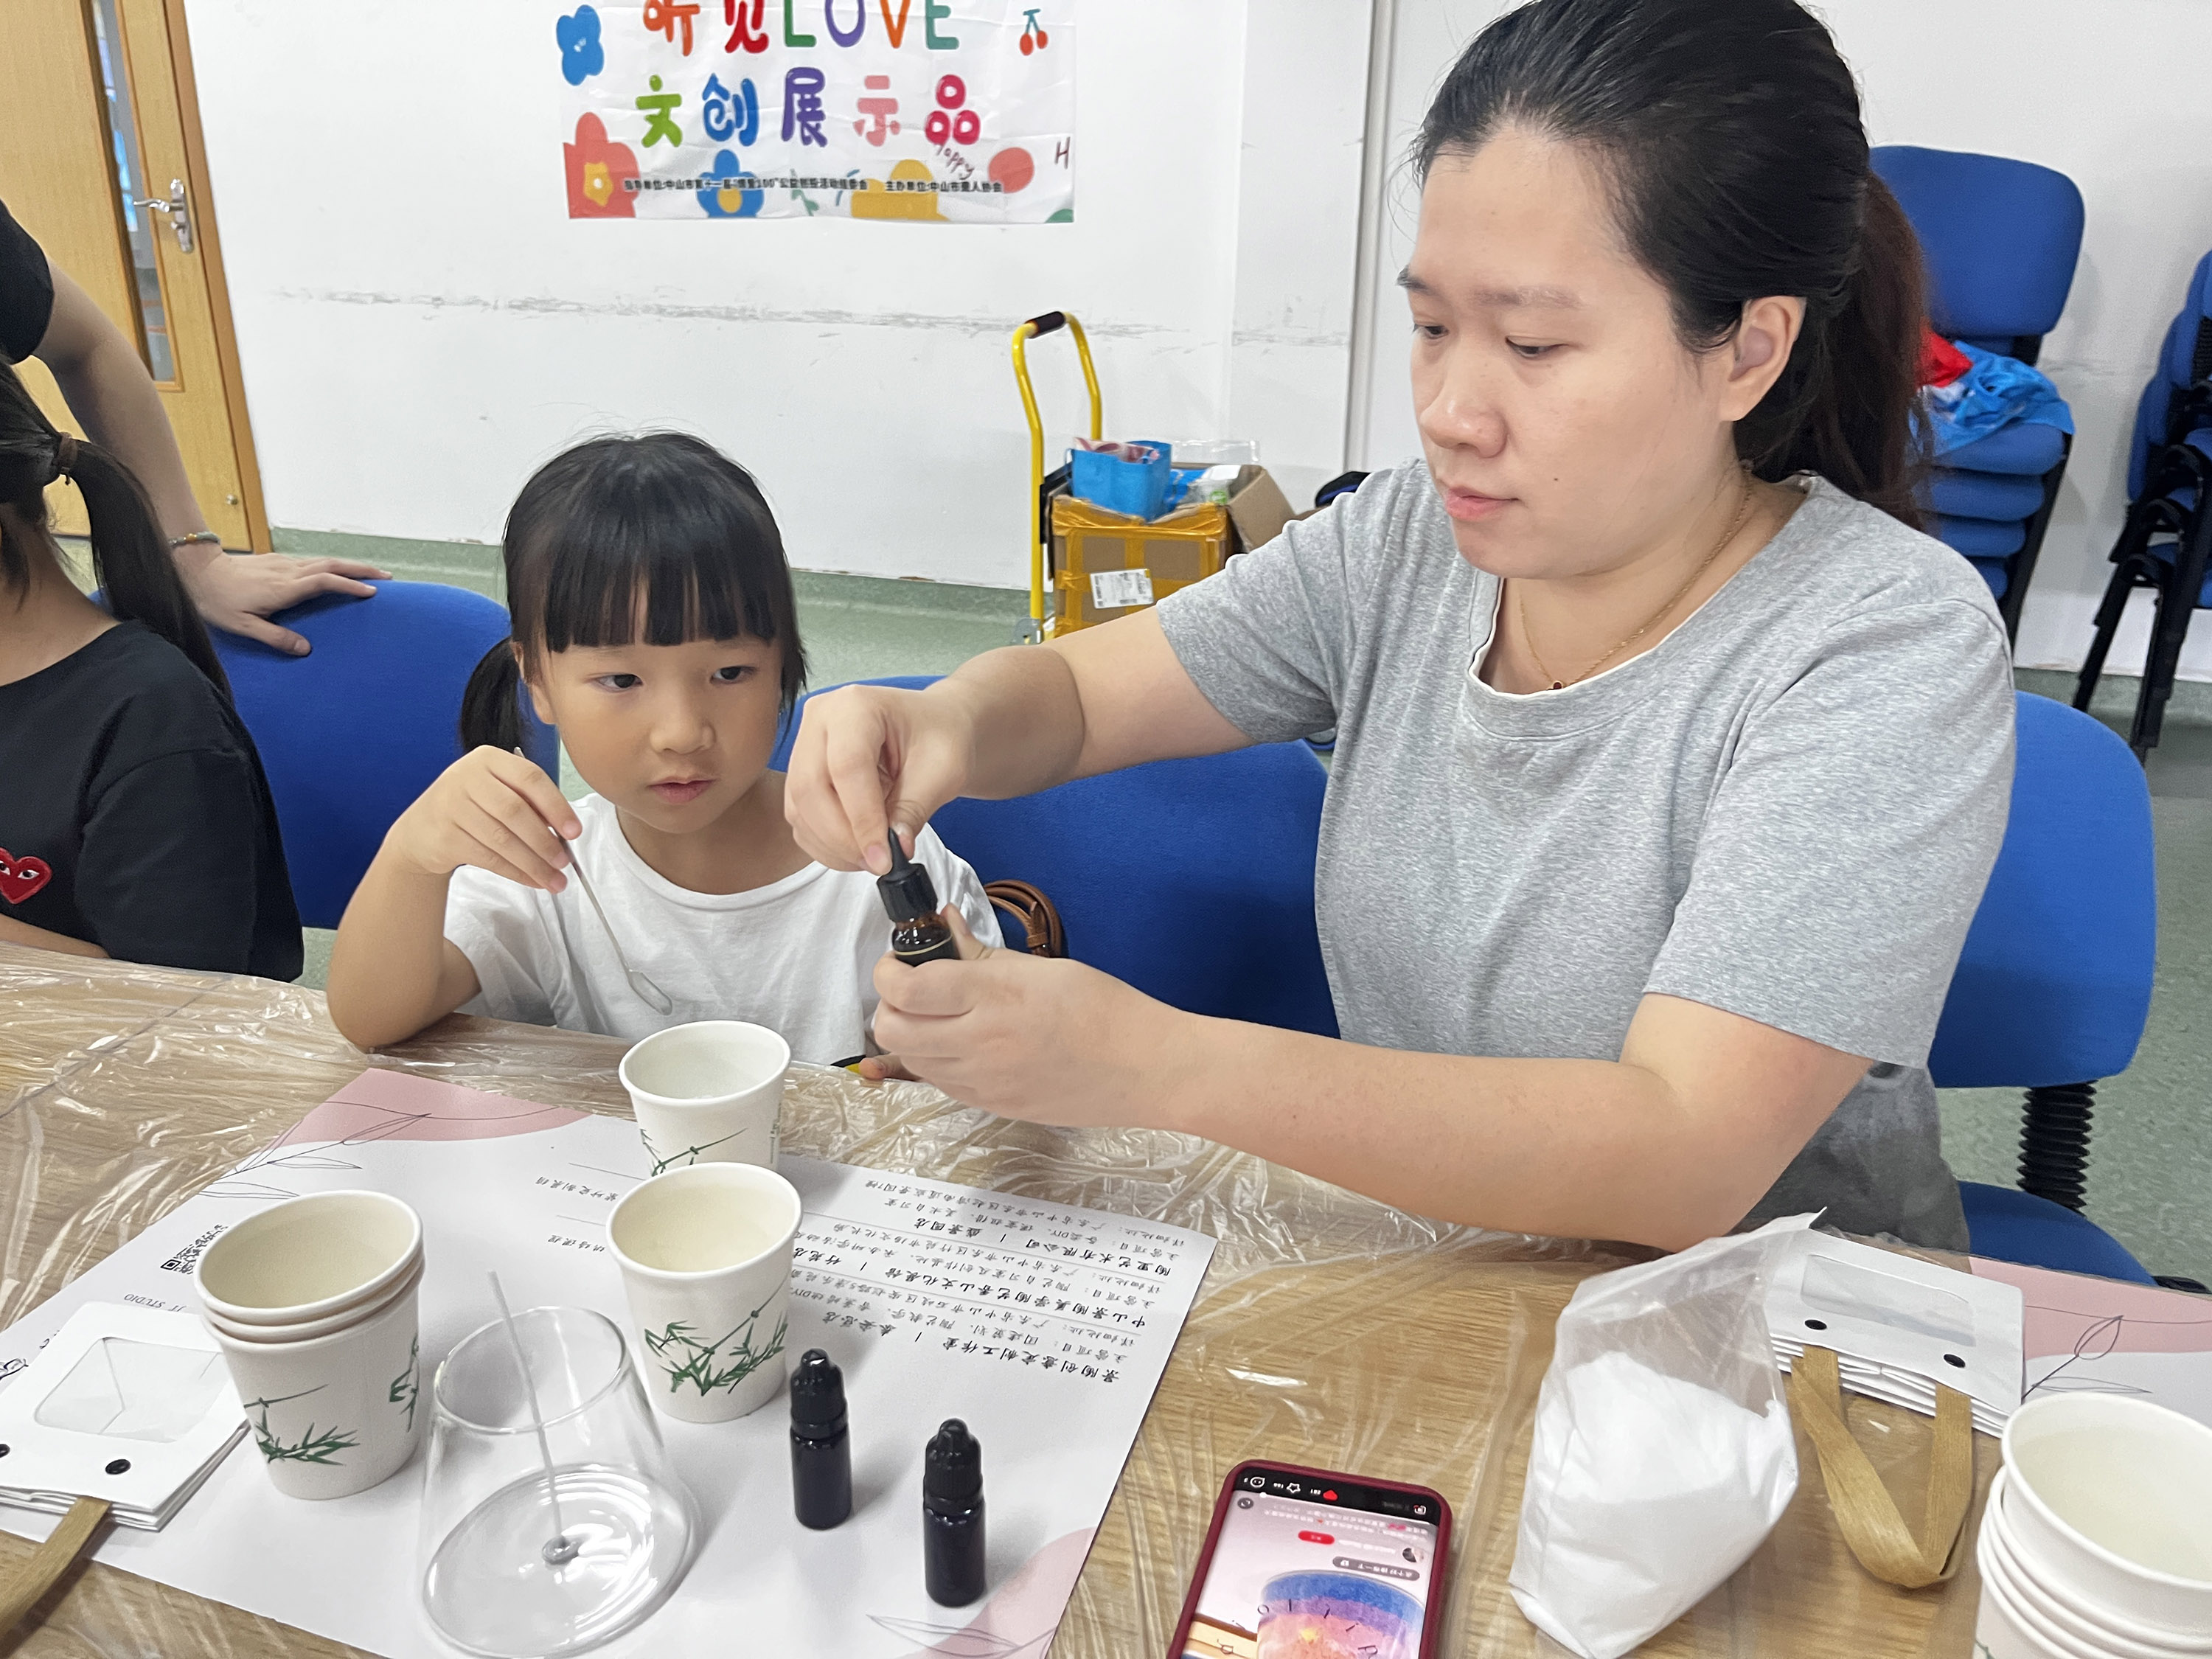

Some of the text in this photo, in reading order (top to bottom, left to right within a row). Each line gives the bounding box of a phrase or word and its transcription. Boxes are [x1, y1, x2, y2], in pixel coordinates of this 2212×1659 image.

[636, 67, 981, 147] 文创展示品
[124, 1294, 166, 1308] STUDIO
[943, 1338, 1119, 1382] 景陶创意定制工作室
